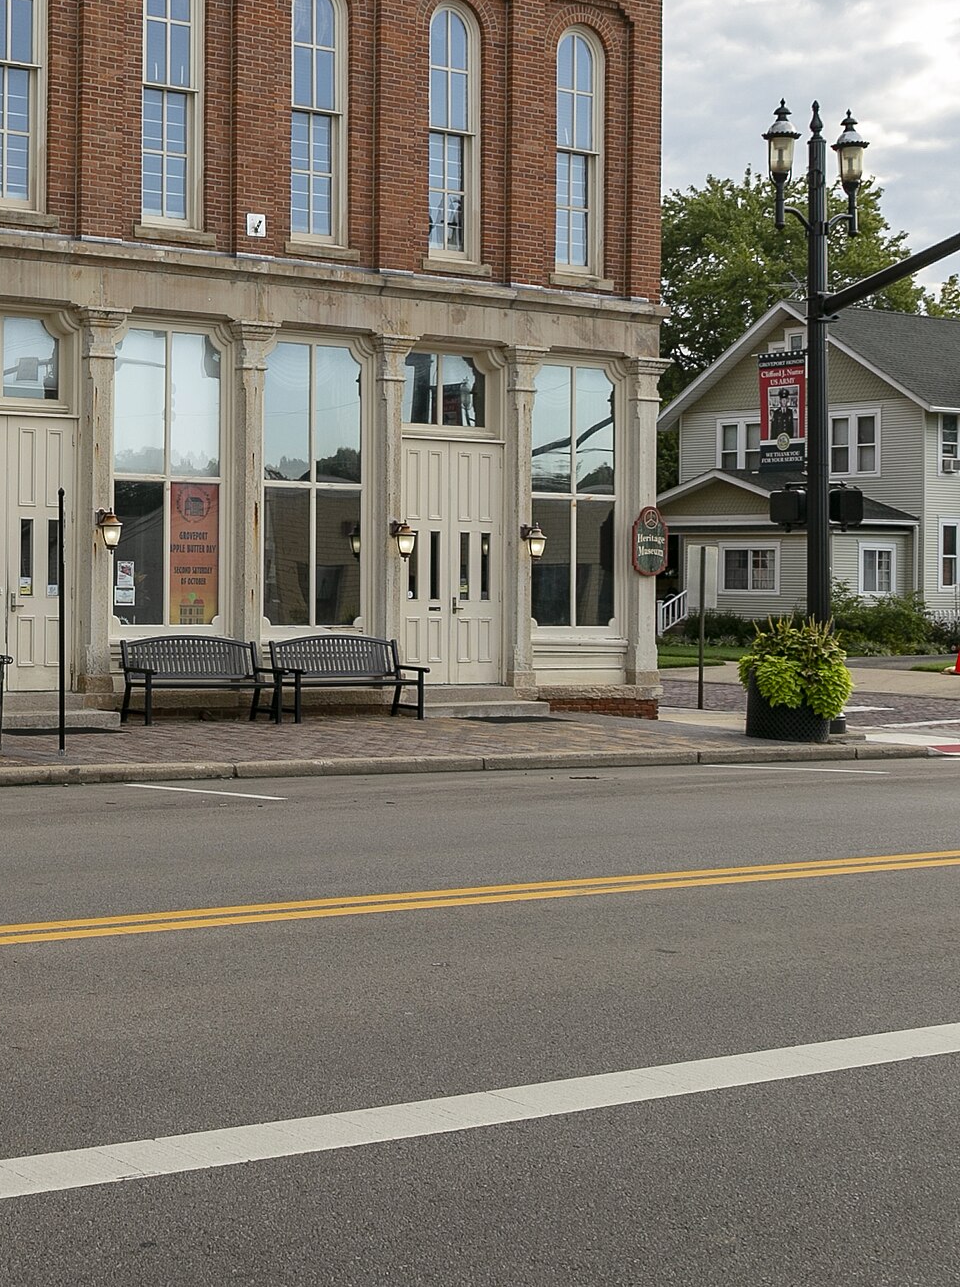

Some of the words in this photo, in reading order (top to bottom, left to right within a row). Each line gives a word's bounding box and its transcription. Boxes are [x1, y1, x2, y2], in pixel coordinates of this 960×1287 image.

[179, 531, 208, 540] GROVEPORT
[637, 533, 665, 544] Heritage
[187, 544, 205, 553] BUTTER
[206, 544, 216, 553] DAY
[638, 545, 664, 557] Museum
[174, 566, 191, 574] SECOND
[188, 577, 206, 585] OCTOBER
